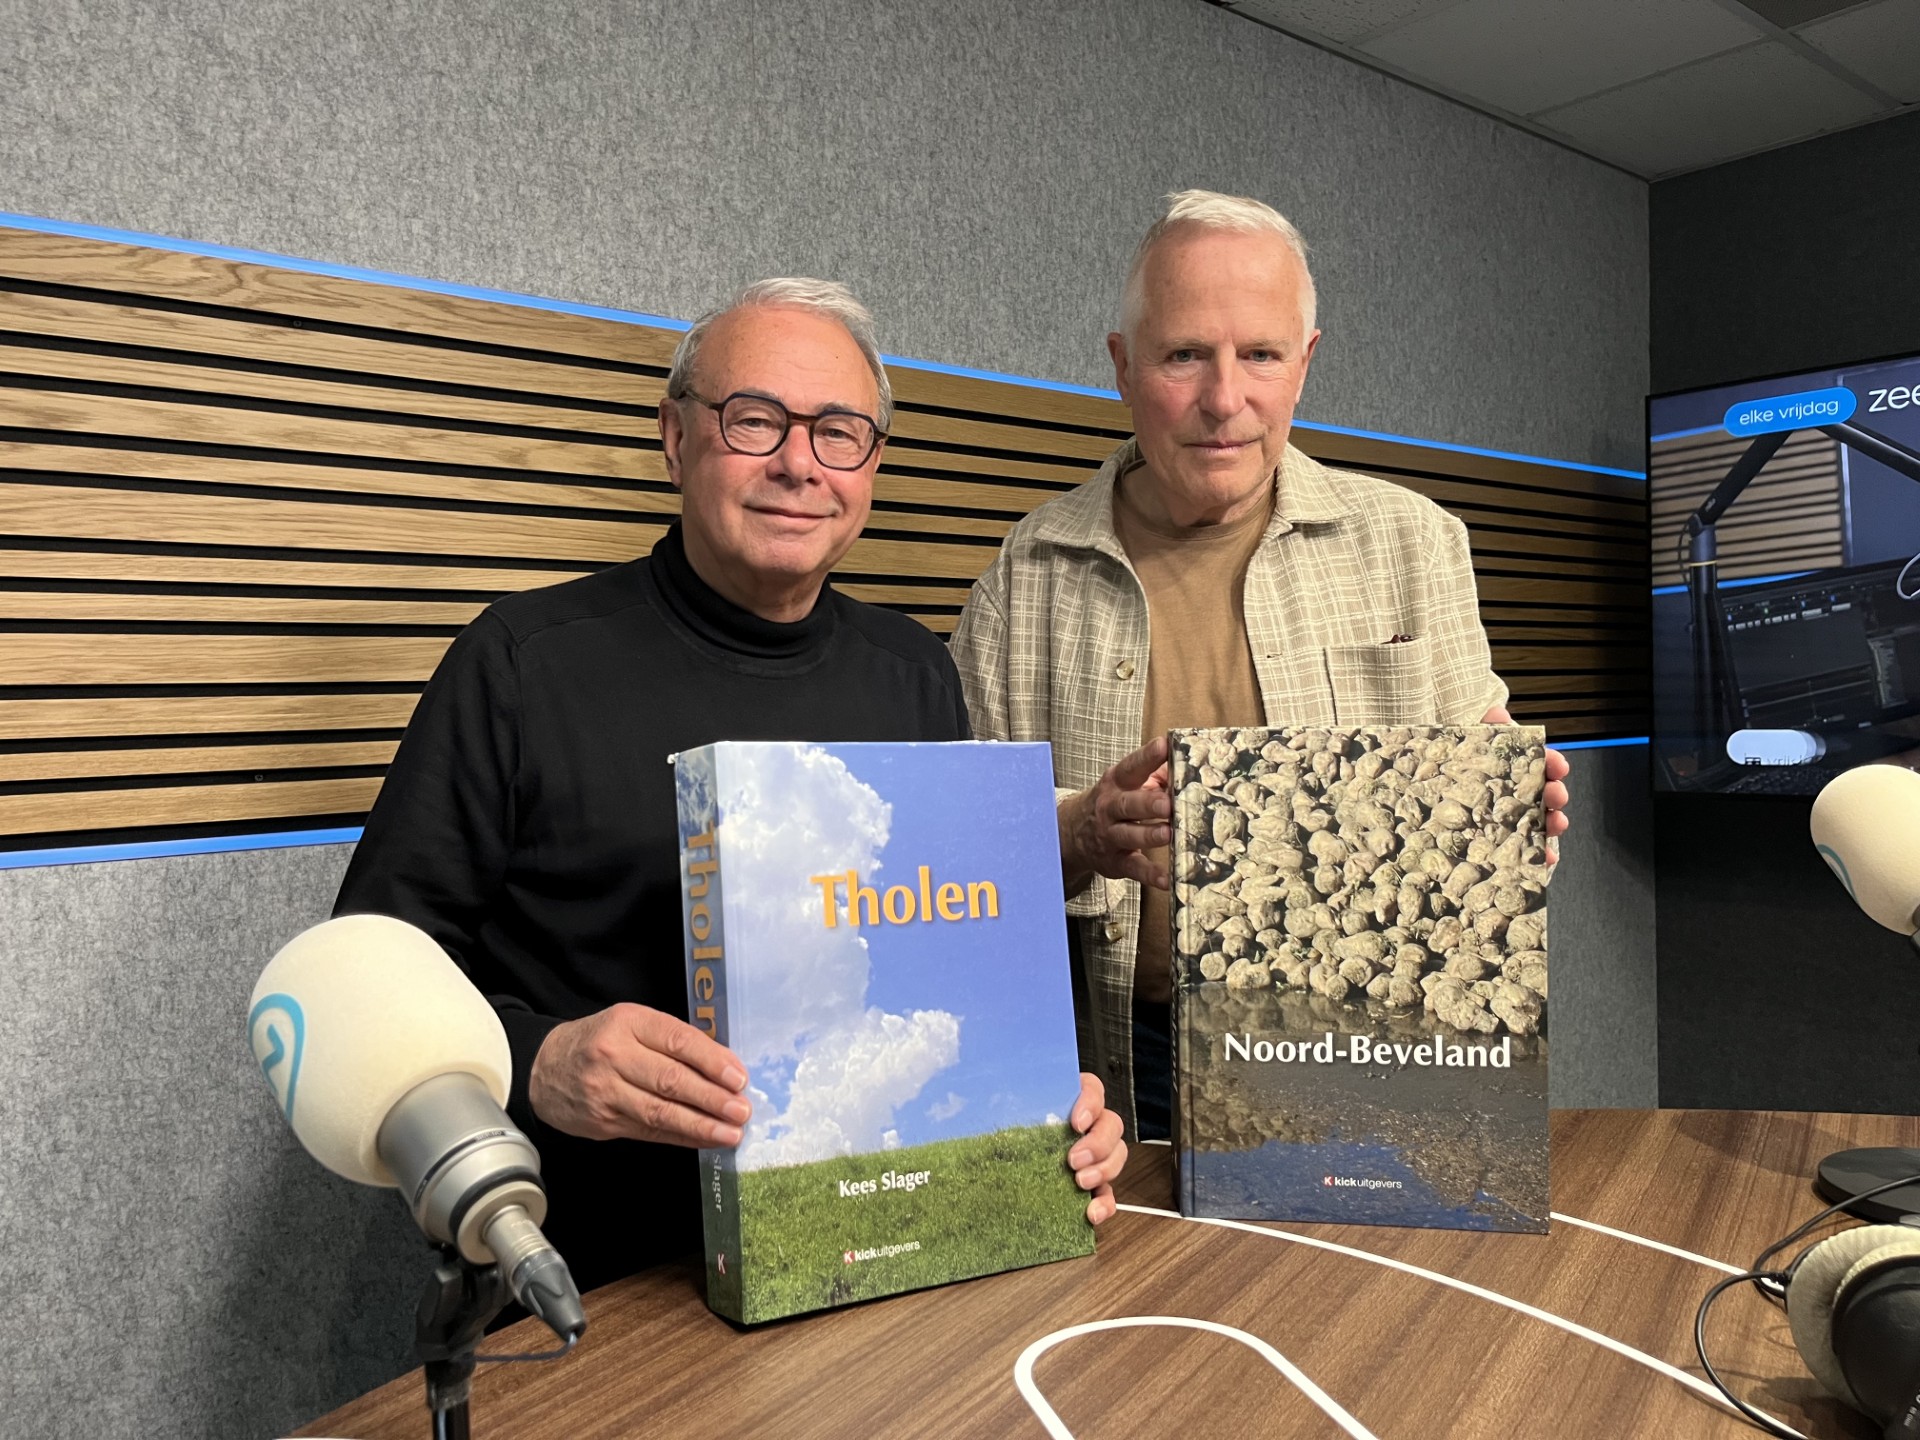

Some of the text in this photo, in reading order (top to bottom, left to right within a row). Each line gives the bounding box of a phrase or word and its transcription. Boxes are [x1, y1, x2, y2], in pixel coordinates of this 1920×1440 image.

[1739, 400, 1839, 426] elke vrijdag
[810, 865, 1000, 929] Tholen
[1224, 1031, 1512, 1068] Noord-Beveland
[839, 1170, 931, 1198] Kees Slager
